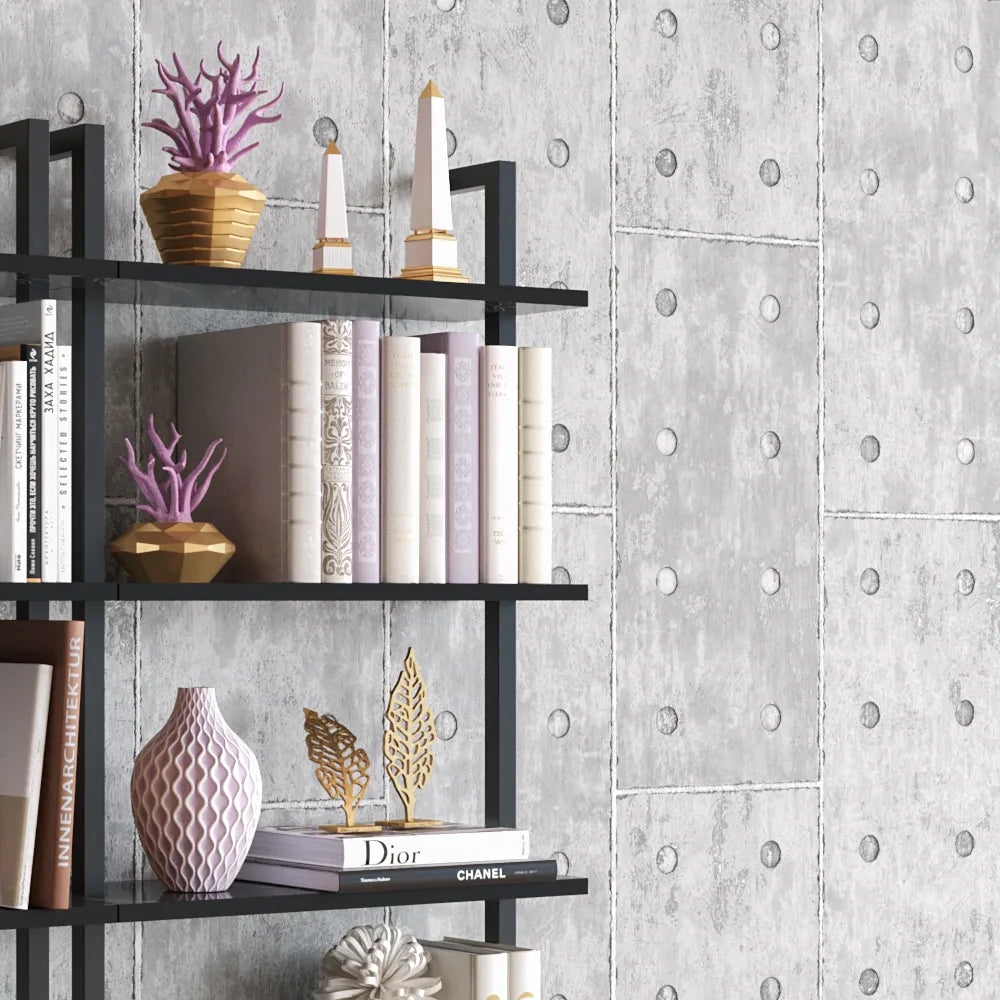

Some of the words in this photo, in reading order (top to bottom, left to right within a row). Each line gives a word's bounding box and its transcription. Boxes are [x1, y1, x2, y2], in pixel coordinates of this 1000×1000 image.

[44, 331, 56, 374] ХАДИД
[44, 382, 55, 413] ЗАХА
[59, 366, 67, 421] STORIES
[29, 419, 37, 454] НАУЧИТЬСЯ
[15, 436, 23, 470] СКЕТЧИНГ
[29, 455, 37, 480] ХОЧЕШЬ
[59, 432, 67, 495] SELECTED
[29, 481, 37, 496] ЕСЛИ
[29, 509, 37, 533] ПРОЧТИ
[57, 636, 81, 867] INNENARCHITEKTUR
[361, 840, 421, 866] Dior
[456, 868, 507, 881] CHANEL
